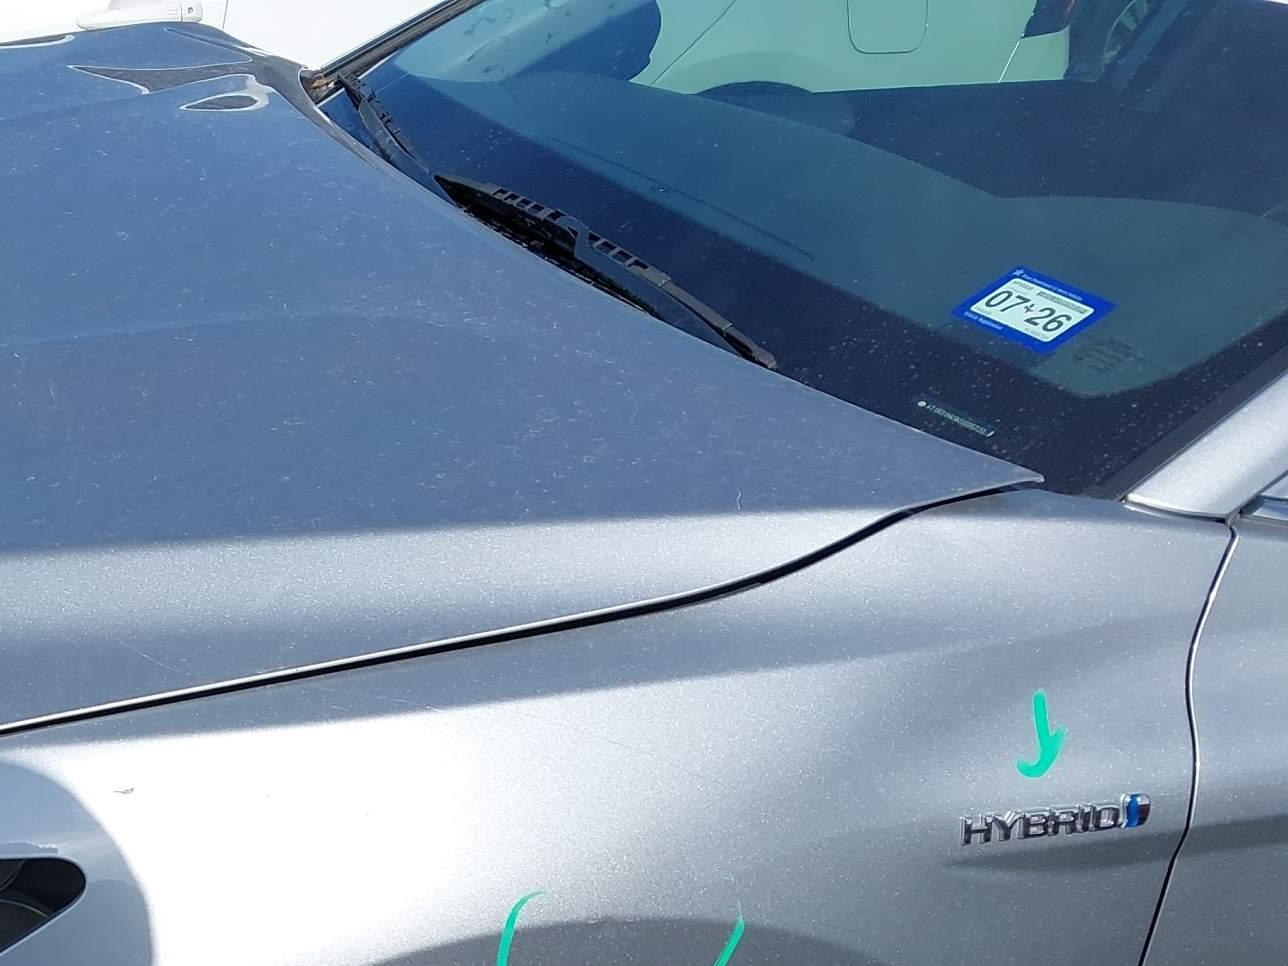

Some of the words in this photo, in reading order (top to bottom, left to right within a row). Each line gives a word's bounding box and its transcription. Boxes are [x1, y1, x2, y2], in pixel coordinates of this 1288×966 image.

[985, 290, 1031, 313] 07
[1024, 307, 1073, 332] 26
[960, 801, 1121, 846] HYBRID
